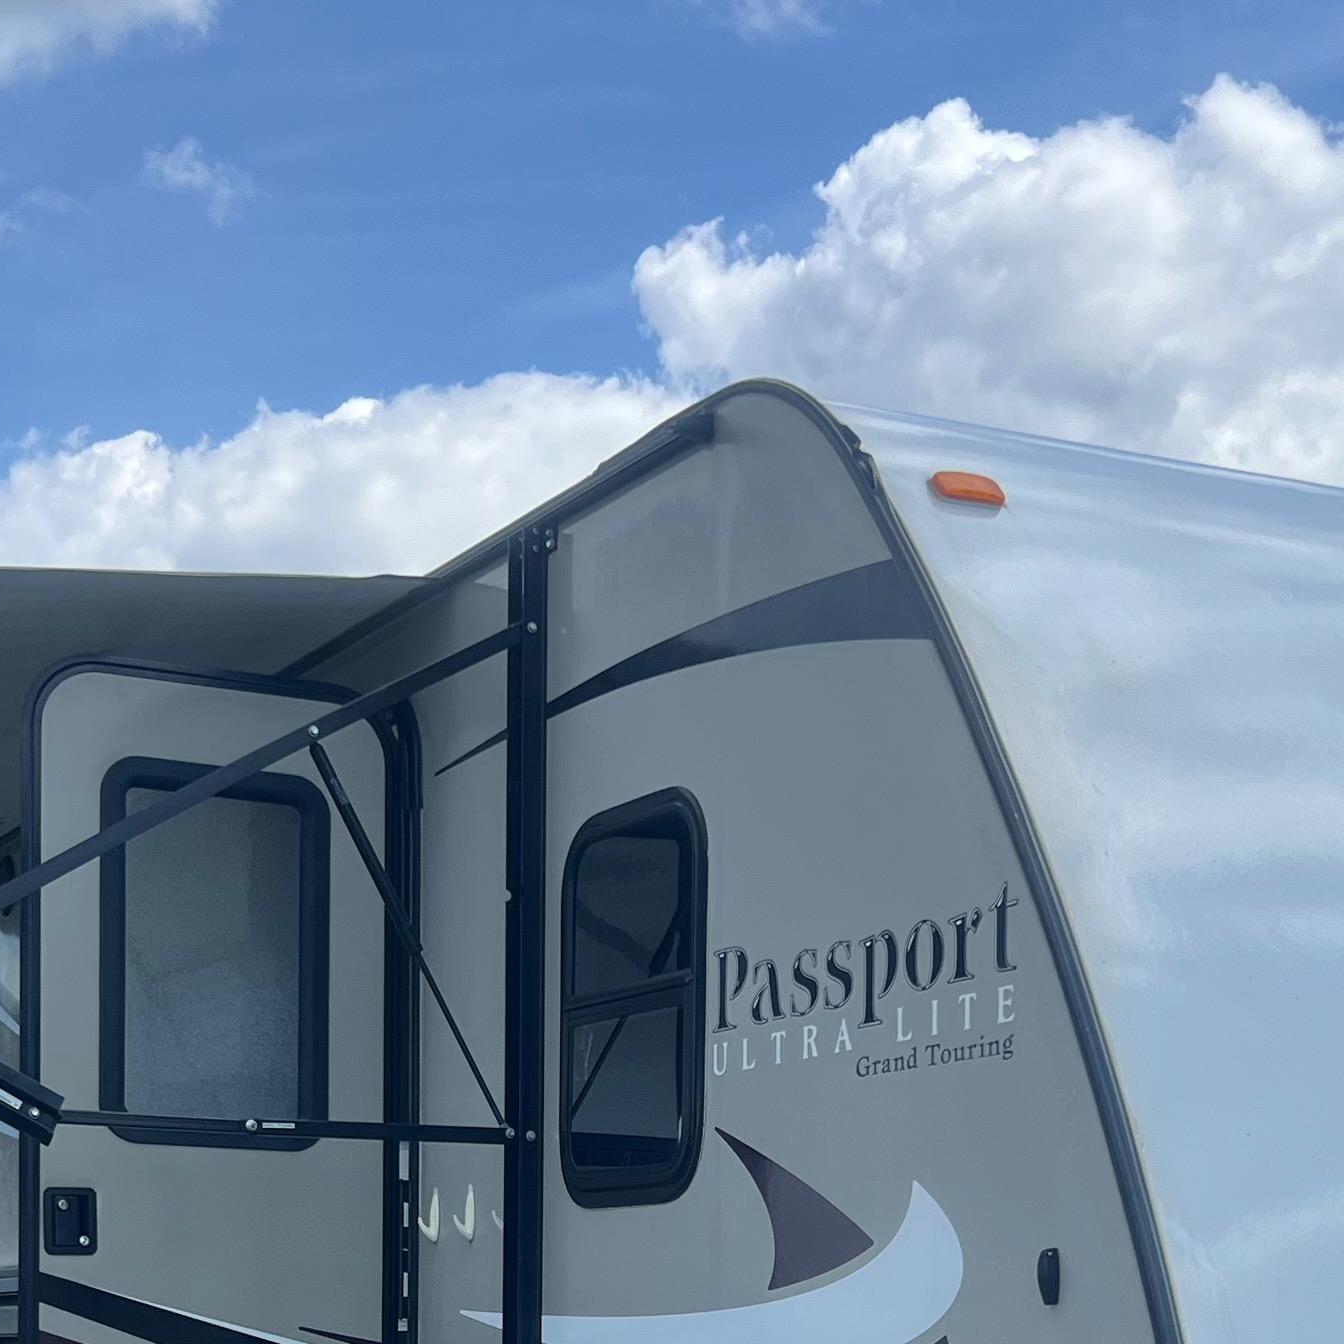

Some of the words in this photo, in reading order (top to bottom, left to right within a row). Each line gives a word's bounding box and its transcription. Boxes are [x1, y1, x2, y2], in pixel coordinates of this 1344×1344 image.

[712, 881, 1019, 1033] Passport
[713, 1018, 853, 1076] ULTRA
[896, 984, 1016, 1042] LITE
[856, 1047, 918, 1078] Grand
[925, 1034, 1014, 1067] Touring
